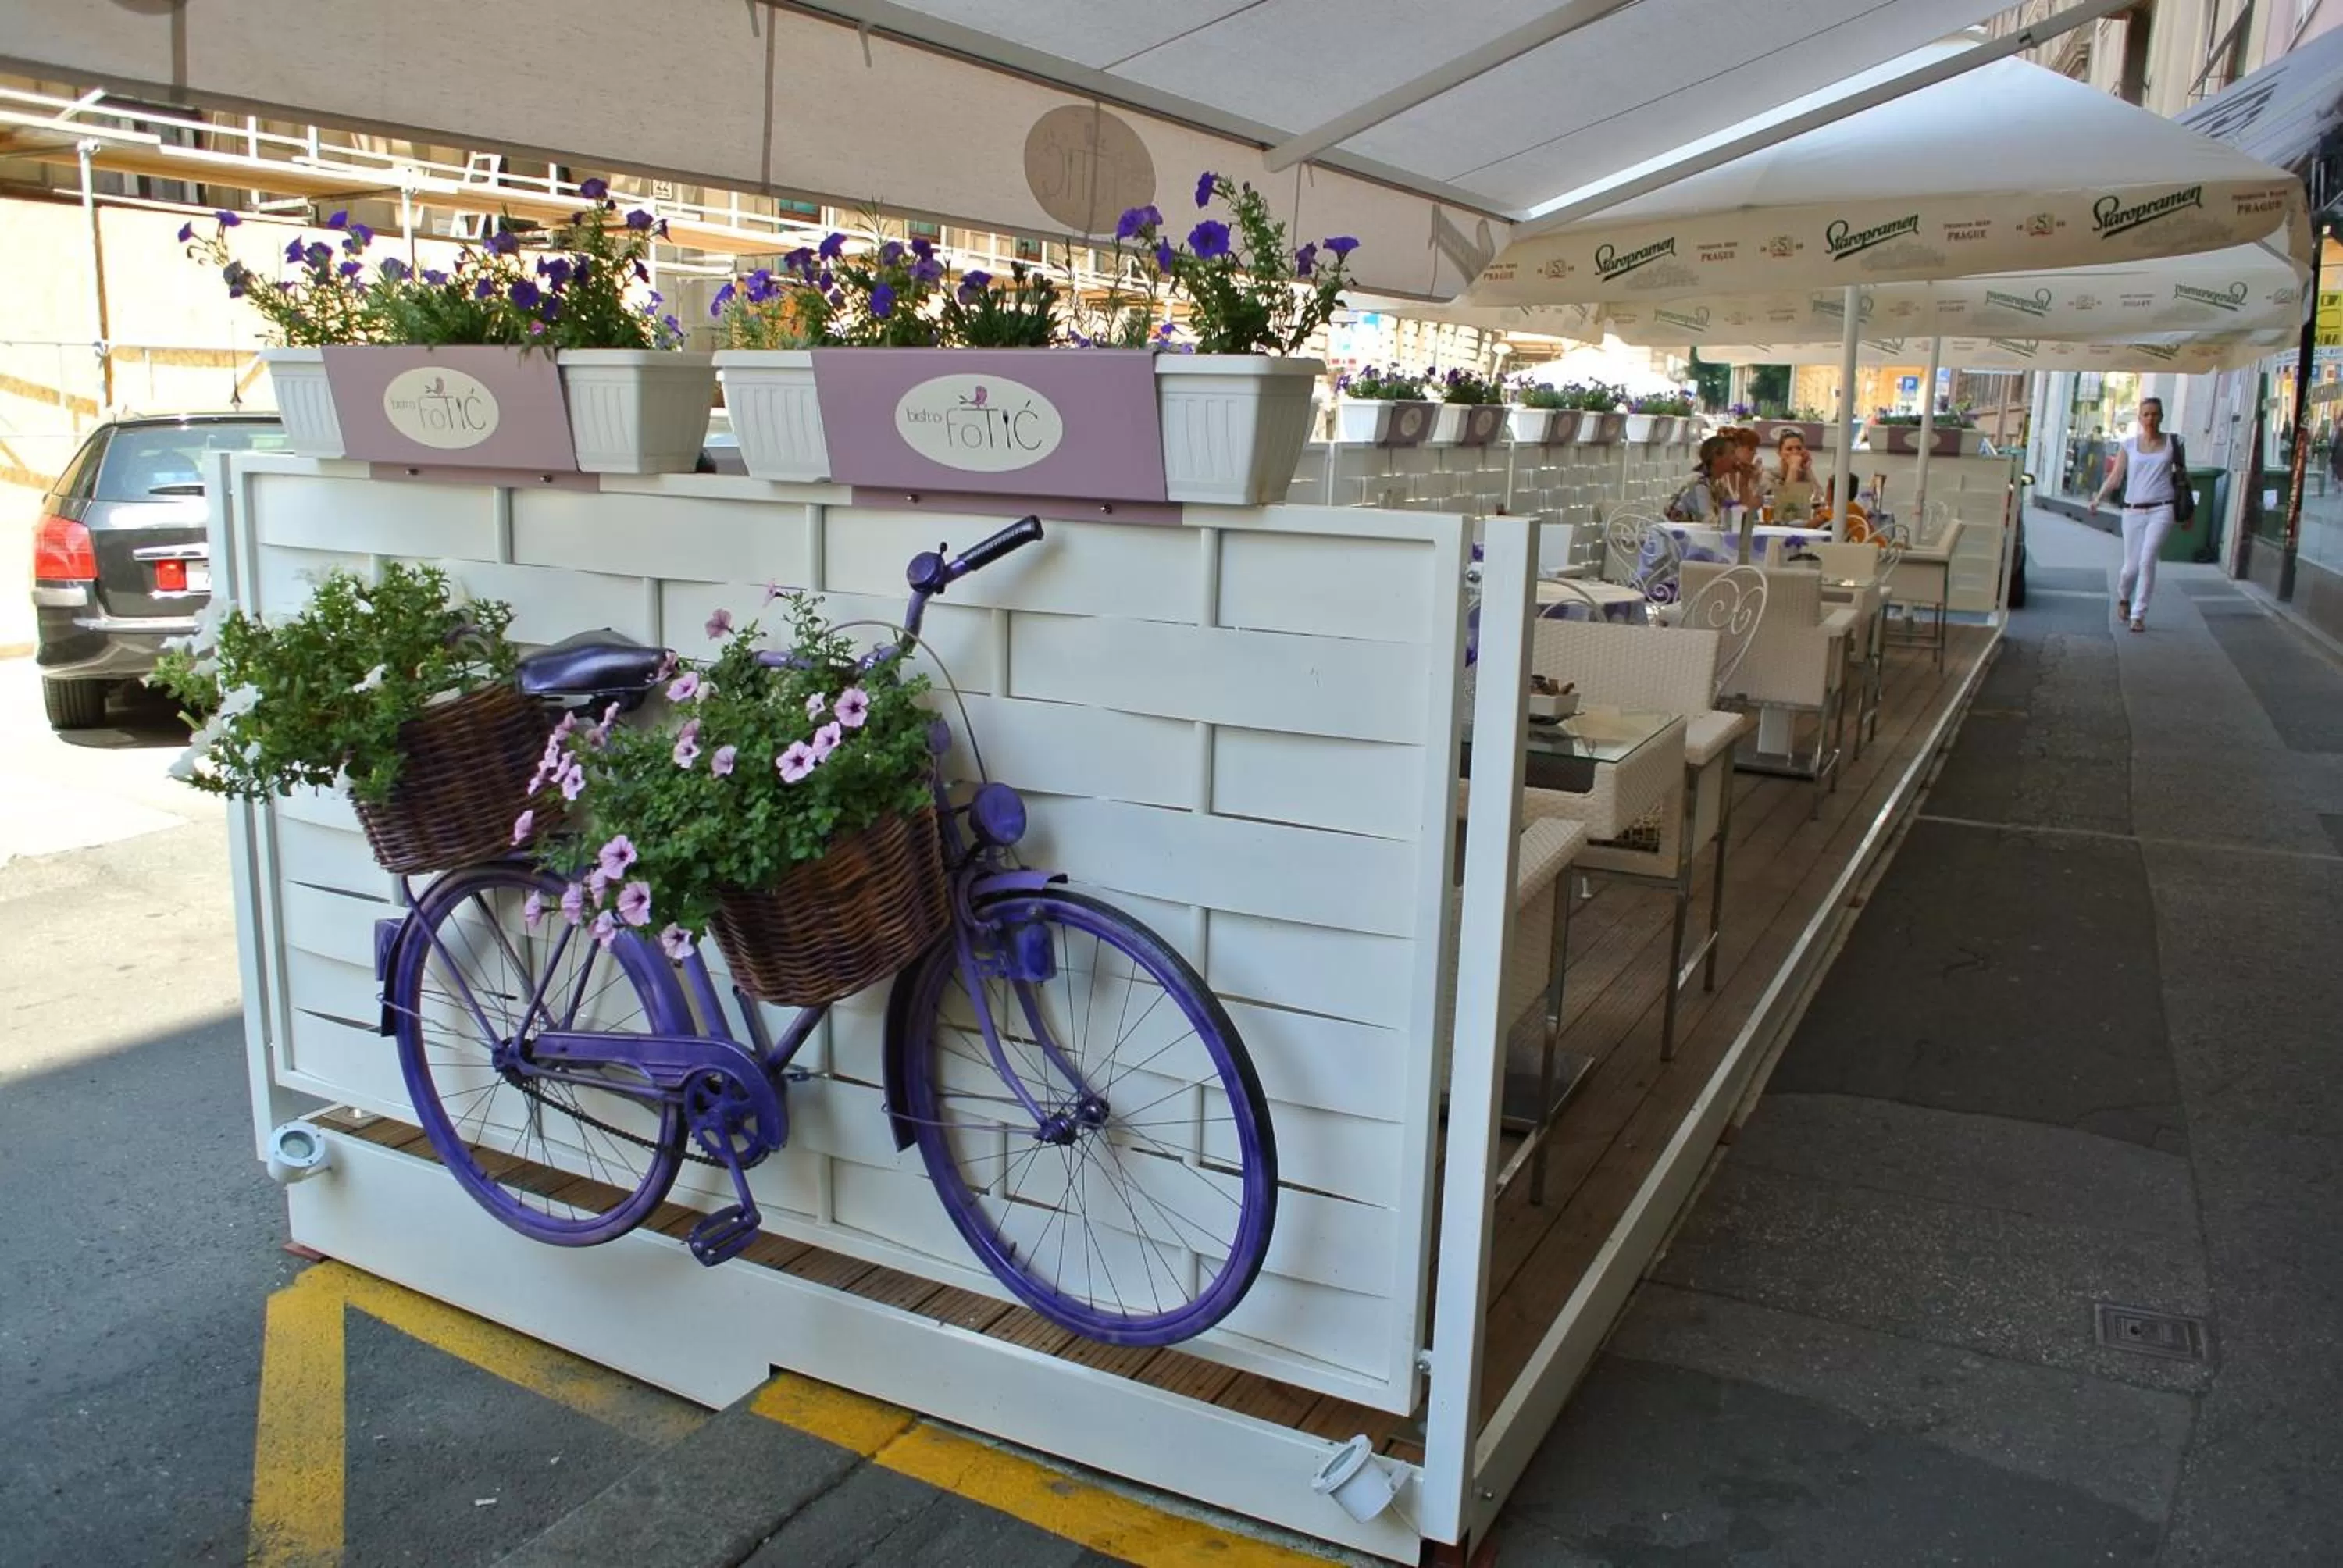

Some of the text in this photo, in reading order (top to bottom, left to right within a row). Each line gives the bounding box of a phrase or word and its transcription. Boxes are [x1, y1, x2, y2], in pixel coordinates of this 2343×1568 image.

[2092, 185, 2203, 239] Staropramen
[1594, 237, 1677, 282] Staropramen
[1824, 213, 1919, 262] Staropramen
